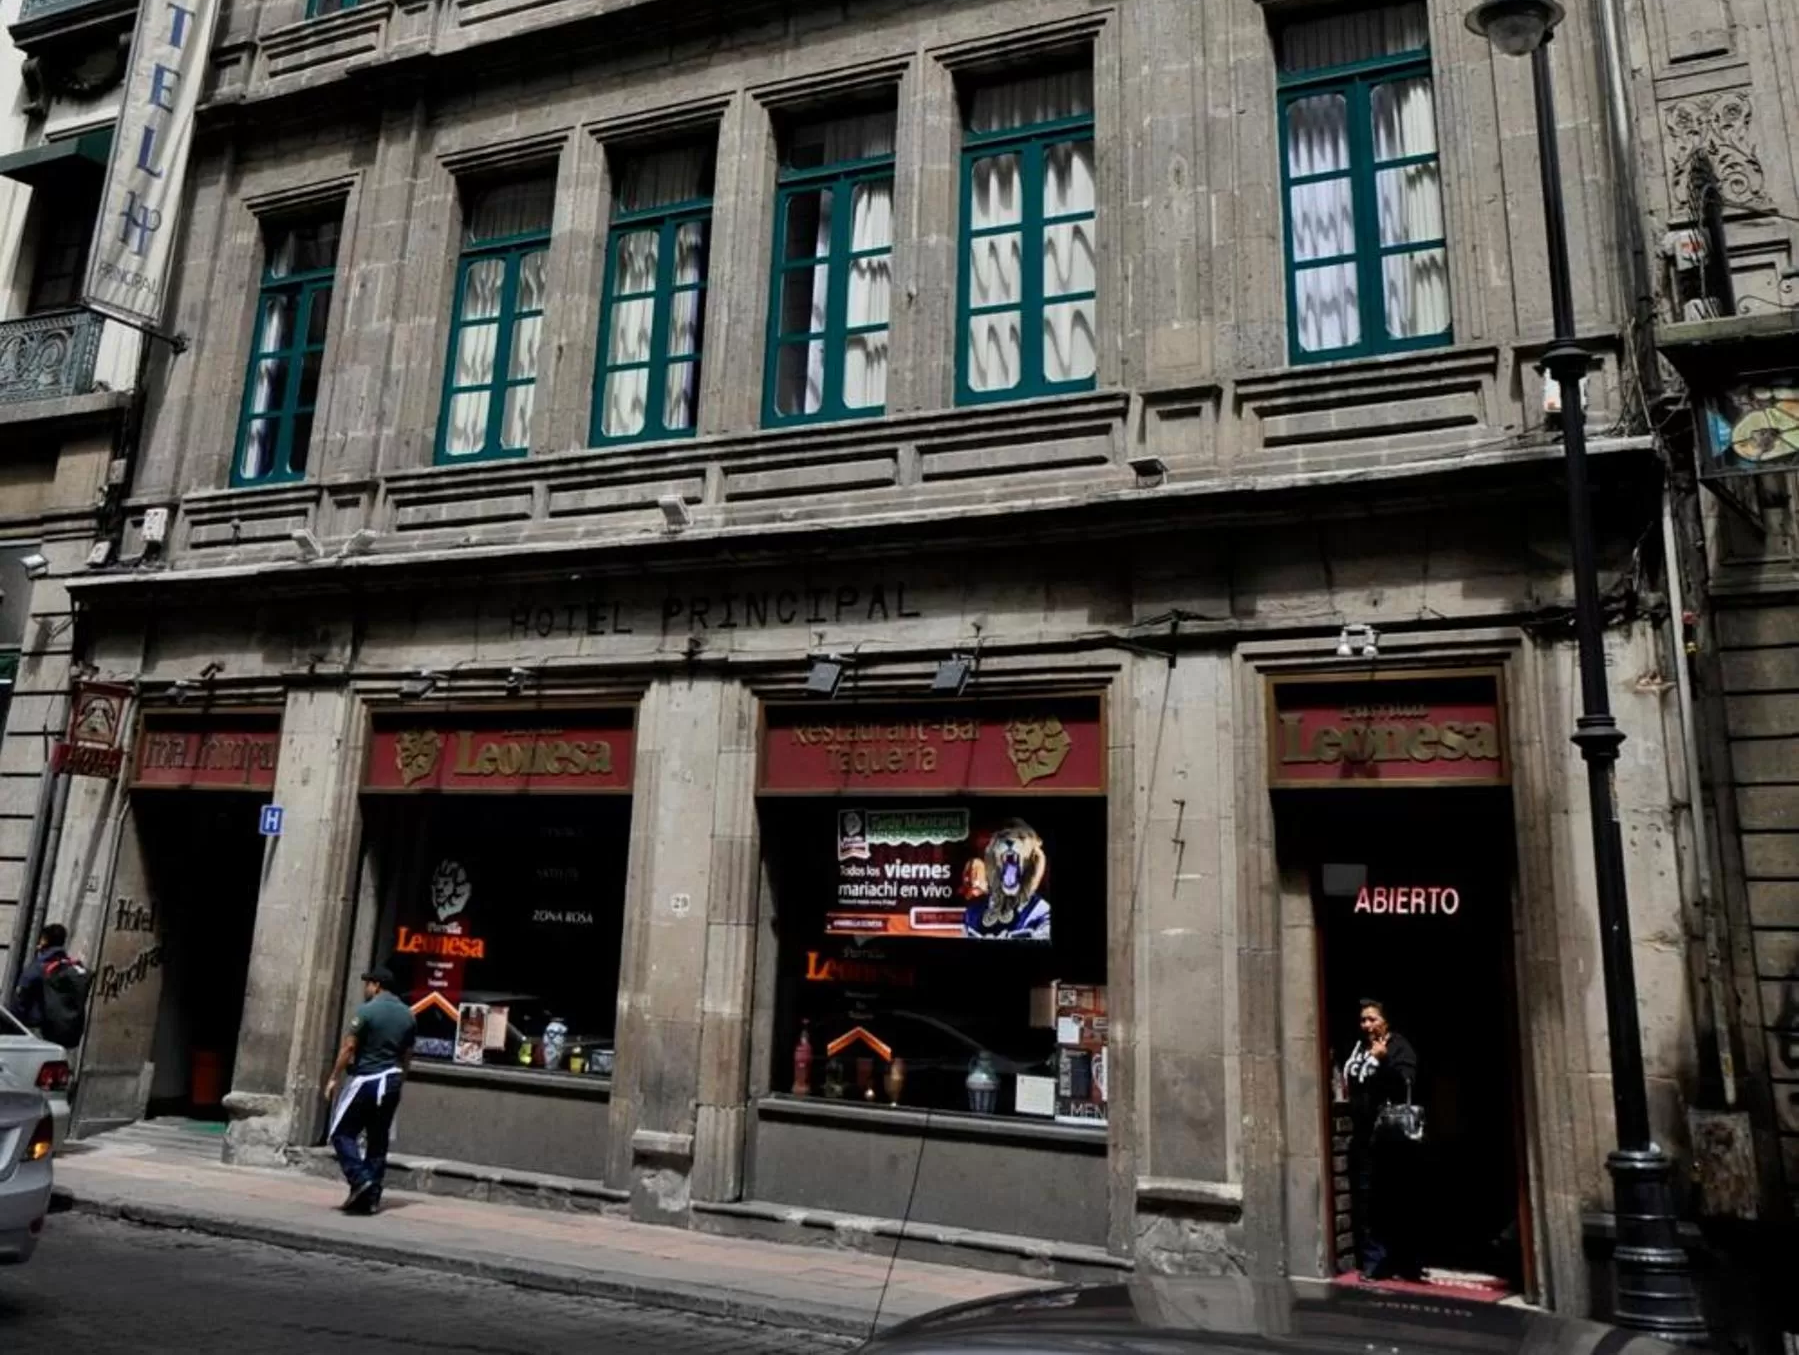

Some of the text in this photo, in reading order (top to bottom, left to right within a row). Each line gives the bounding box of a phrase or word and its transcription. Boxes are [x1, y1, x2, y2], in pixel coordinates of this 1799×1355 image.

[510, 581, 920, 638] HOTEL PRINCIPAL
[453, 729, 611, 776] Leonesa
[1280, 713, 1498, 763] Leonesa
[263, 811, 280, 832] H
[840, 865, 866, 877] Todos
[883, 858, 951, 880] viernes
[838, 881, 952, 898] mariachi en vivo
[1353, 886, 1460, 915] ABIERTO
[395, 925, 485, 959] Leonesa
